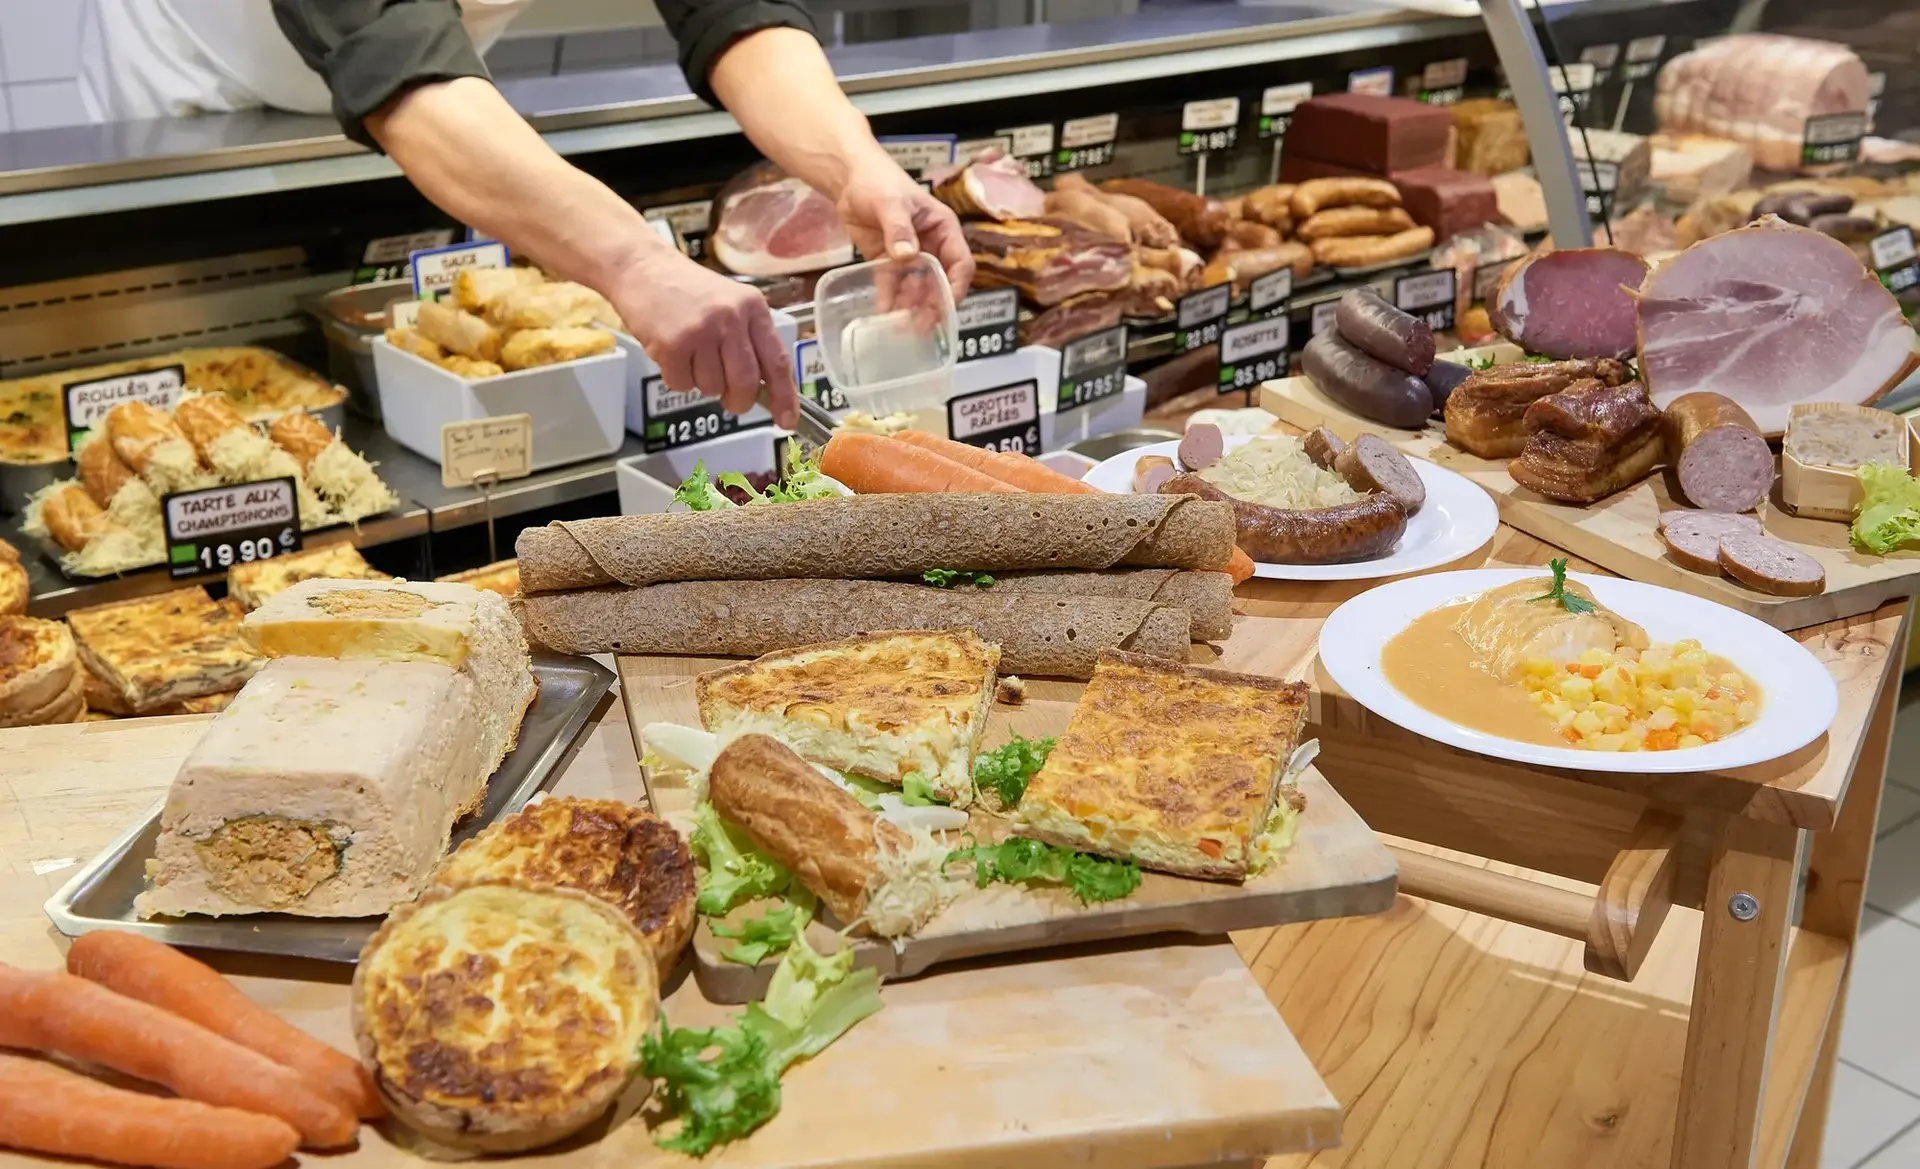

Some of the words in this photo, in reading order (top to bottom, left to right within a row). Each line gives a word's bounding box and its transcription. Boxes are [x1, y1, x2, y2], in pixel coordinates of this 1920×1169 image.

[157, 380, 173, 390] AU
[961, 390, 1027, 416] CAROTTES
[181, 494, 236, 515] TARTE
[244, 488, 281, 505] AUX
[177, 504, 289, 533] CHAMPIGNONS
